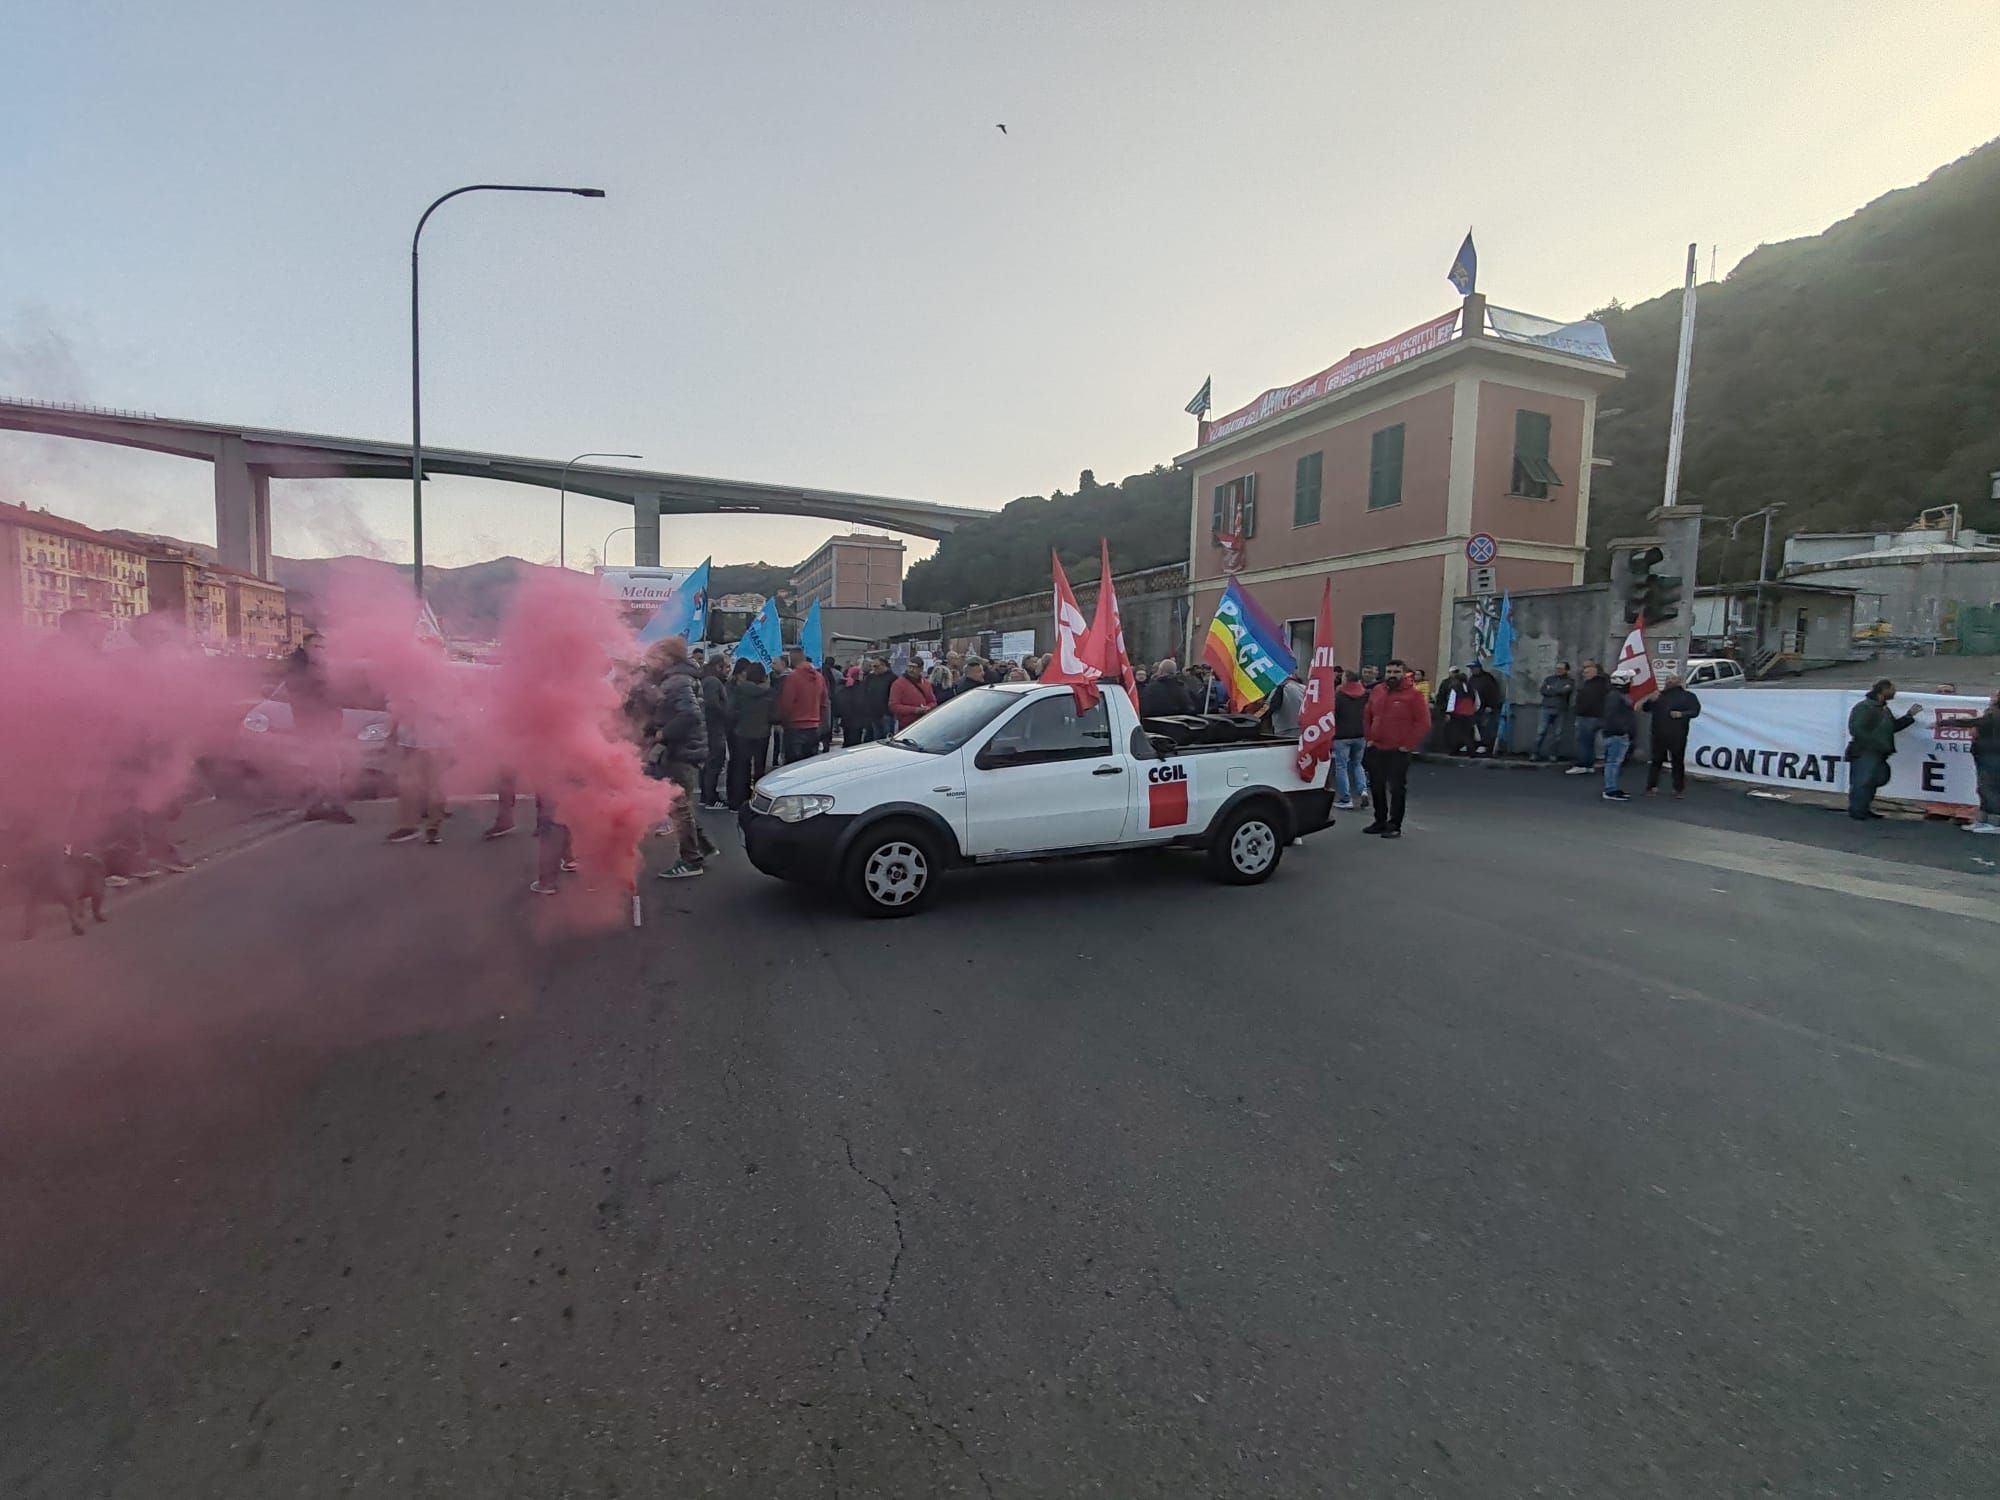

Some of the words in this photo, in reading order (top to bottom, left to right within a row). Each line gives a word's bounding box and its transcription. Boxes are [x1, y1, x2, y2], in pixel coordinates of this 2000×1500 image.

[621, 586, 672, 598] Meland
[1214, 600, 1274, 679] PACE
[1940, 730, 1974, 739] CGIL
[1934, 742, 1972, 753] ARE
[1148, 764, 1187, 783] CGIL
[1922, 753, 1946, 793] È
